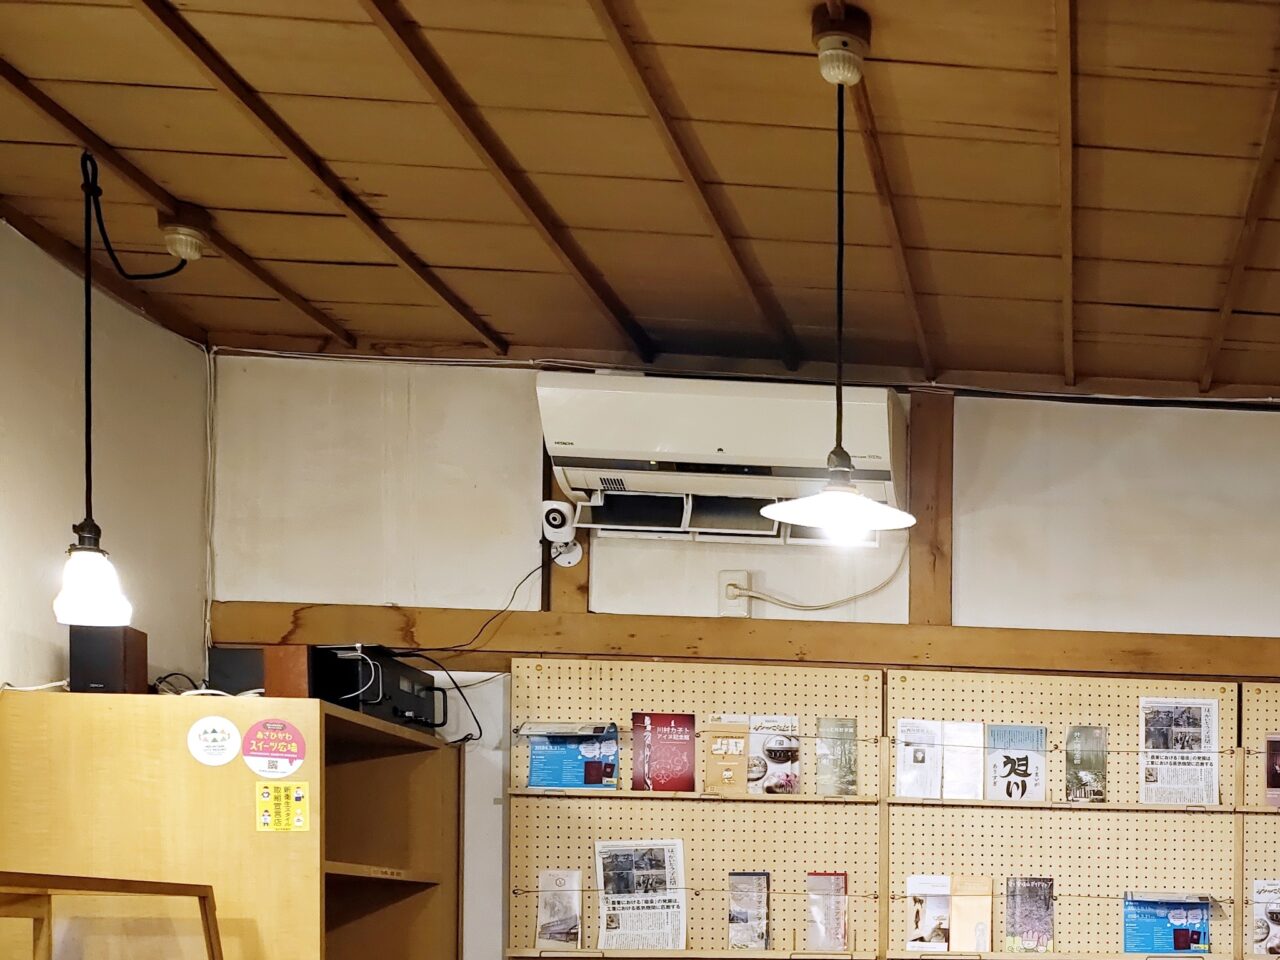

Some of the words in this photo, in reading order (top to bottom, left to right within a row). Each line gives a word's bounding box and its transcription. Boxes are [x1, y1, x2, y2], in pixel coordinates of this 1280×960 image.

[256, 731, 293, 741] あさひかわ
[249, 740, 298, 753] スイーツ広場
